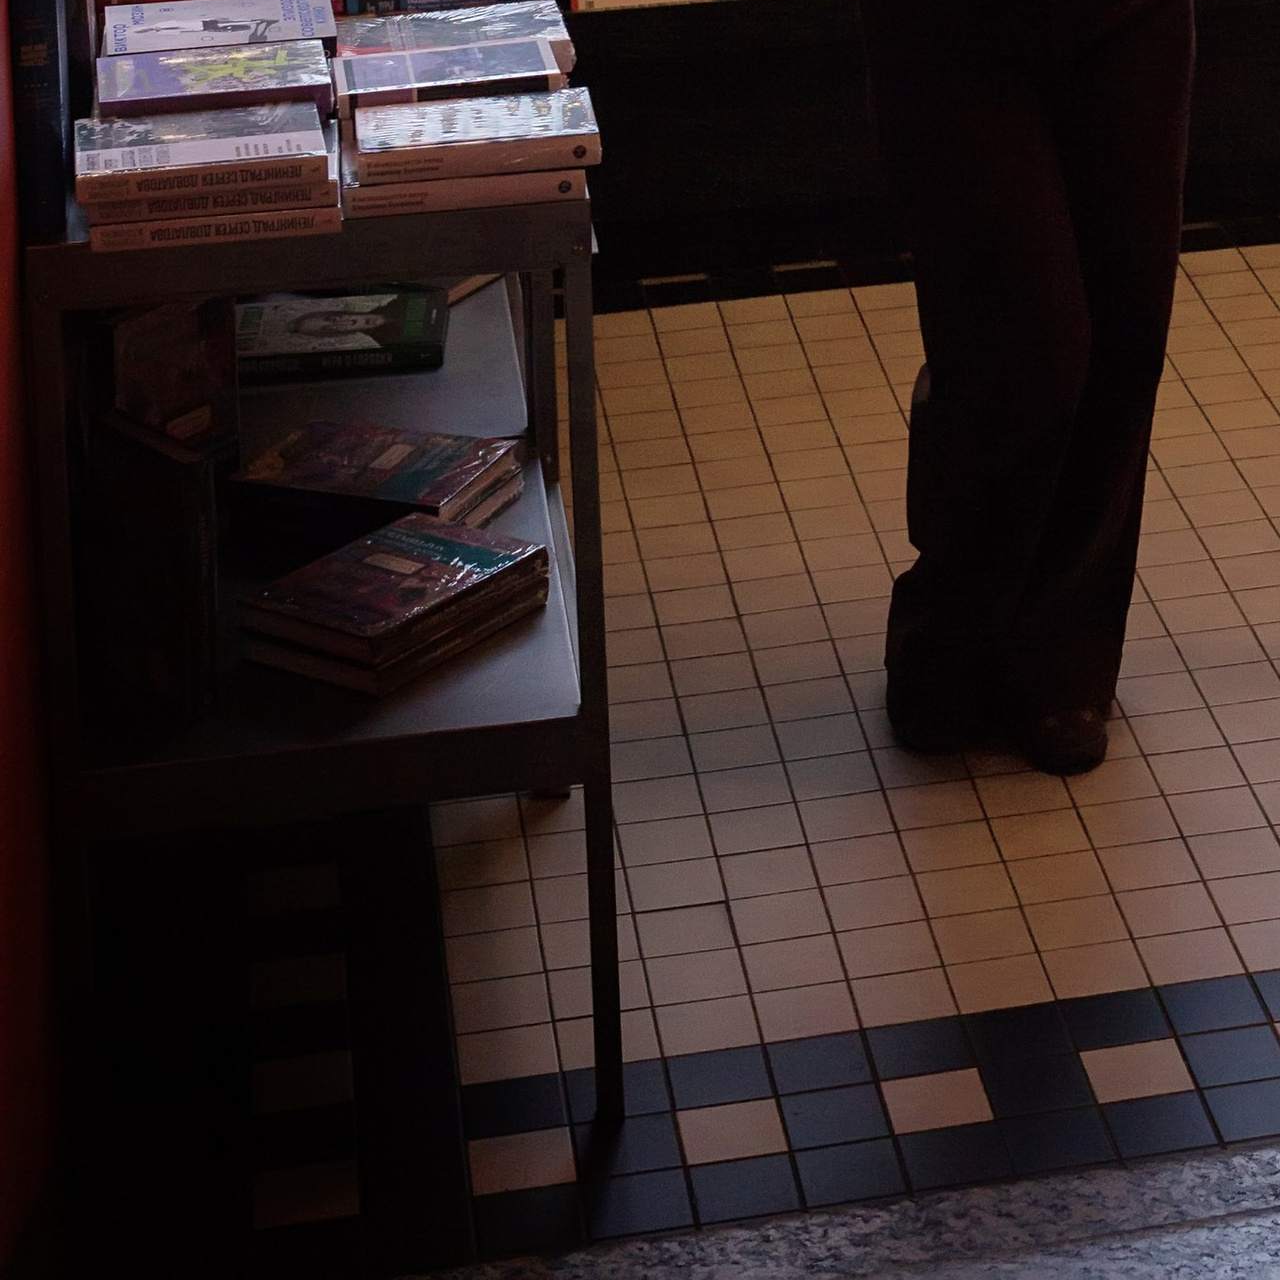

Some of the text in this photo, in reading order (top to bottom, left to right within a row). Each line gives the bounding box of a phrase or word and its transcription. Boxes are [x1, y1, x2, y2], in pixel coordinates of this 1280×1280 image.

[136, 164, 302, 193] ЛЕНИНГРАД СЕРГЕЯ ДОВЛАТОВА
[147, 188, 312, 214] ЛЕНИНГРАД СЕРГЕЯ ДОВЛАТОВА
[150, 215, 315, 242] ЛЕНИНГРАД СЕРГЕЯ ДОВЛАТОВА
